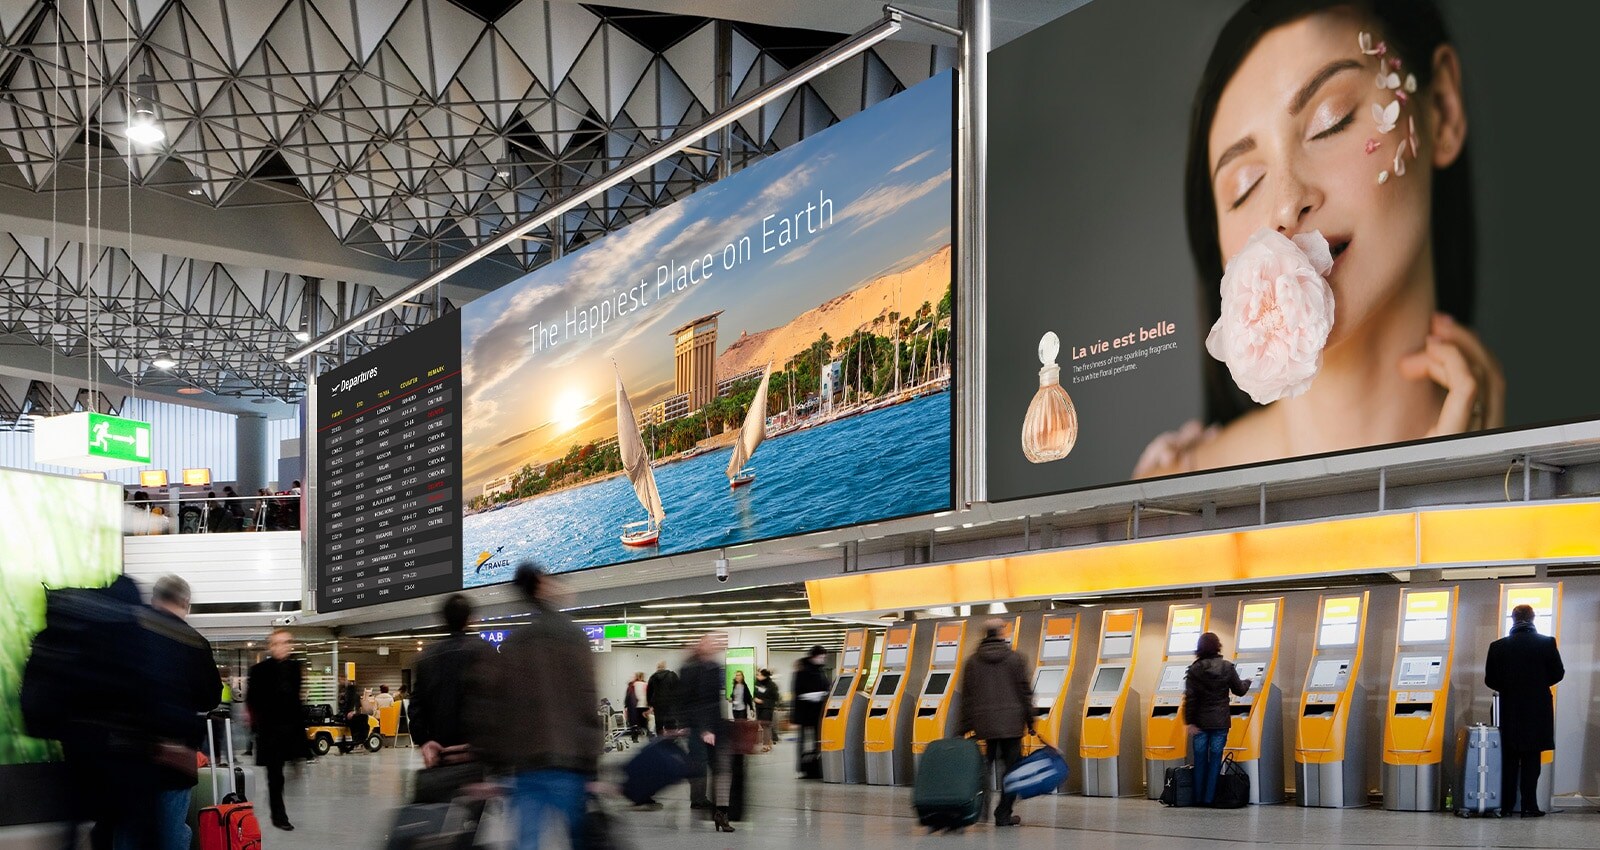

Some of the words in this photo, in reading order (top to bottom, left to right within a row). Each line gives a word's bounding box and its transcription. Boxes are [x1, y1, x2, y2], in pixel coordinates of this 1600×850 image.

[529, 320, 558, 354] The
[565, 279, 648, 338] Happiest
[657, 253, 713, 300] Place
[723, 236, 750, 270] on
[763, 190, 833, 254] Earth
[1072, 346, 1087, 360] La
[1090, 340, 1109, 356] vie
[1113, 332, 1135, 348] est
[1140, 320, 1175, 341] belle
[1073, 365, 1082, 373] The
[1082, 359, 1106, 370] freshness
[1107, 356, 1113, 364] of
[1114, 355, 1122, 363] the
[1124, 349, 1148, 361] sparkling
[1149, 342, 1177, 354] fragrance,
[341, 366, 378, 392] Departures
[1085, 372, 1099, 380] white
[1099, 368, 1112, 377] floral
[428, 434, 440, 442] CHECK
[428, 446, 440, 454] CHECK
[428, 458, 440, 466] CHECK
[428, 470, 440, 478] CHECK
[484, 560, 509, 571] TRAVEL
